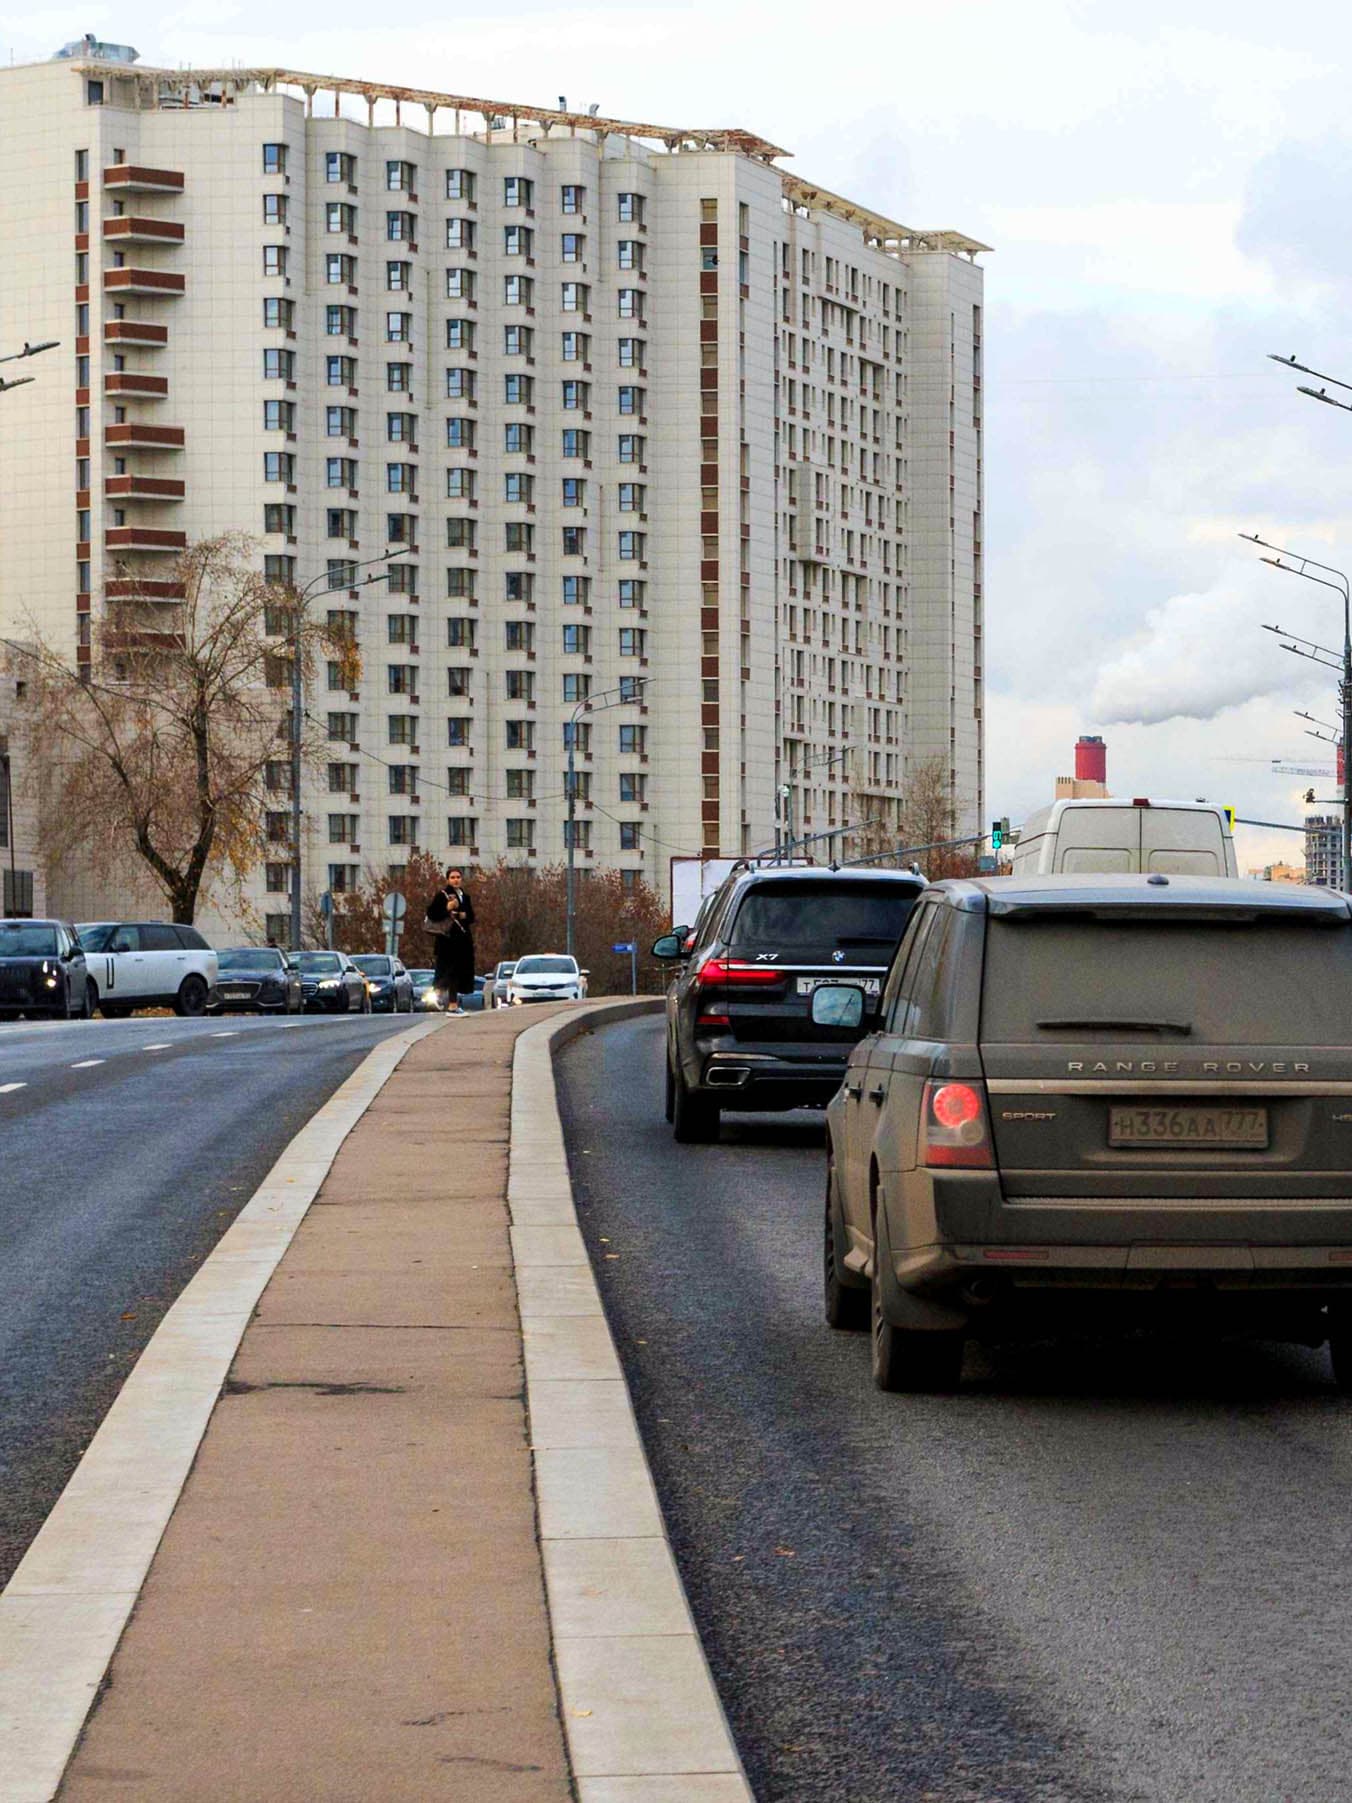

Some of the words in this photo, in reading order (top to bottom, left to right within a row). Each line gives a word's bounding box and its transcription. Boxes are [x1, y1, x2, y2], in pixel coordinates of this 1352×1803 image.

[756, 953, 779, 961] X7
[1067, 1062, 1178, 1072] RANGE
[1203, 1062, 1310, 1073] ROVER
[1002, 1112, 1057, 1121] SPORT
